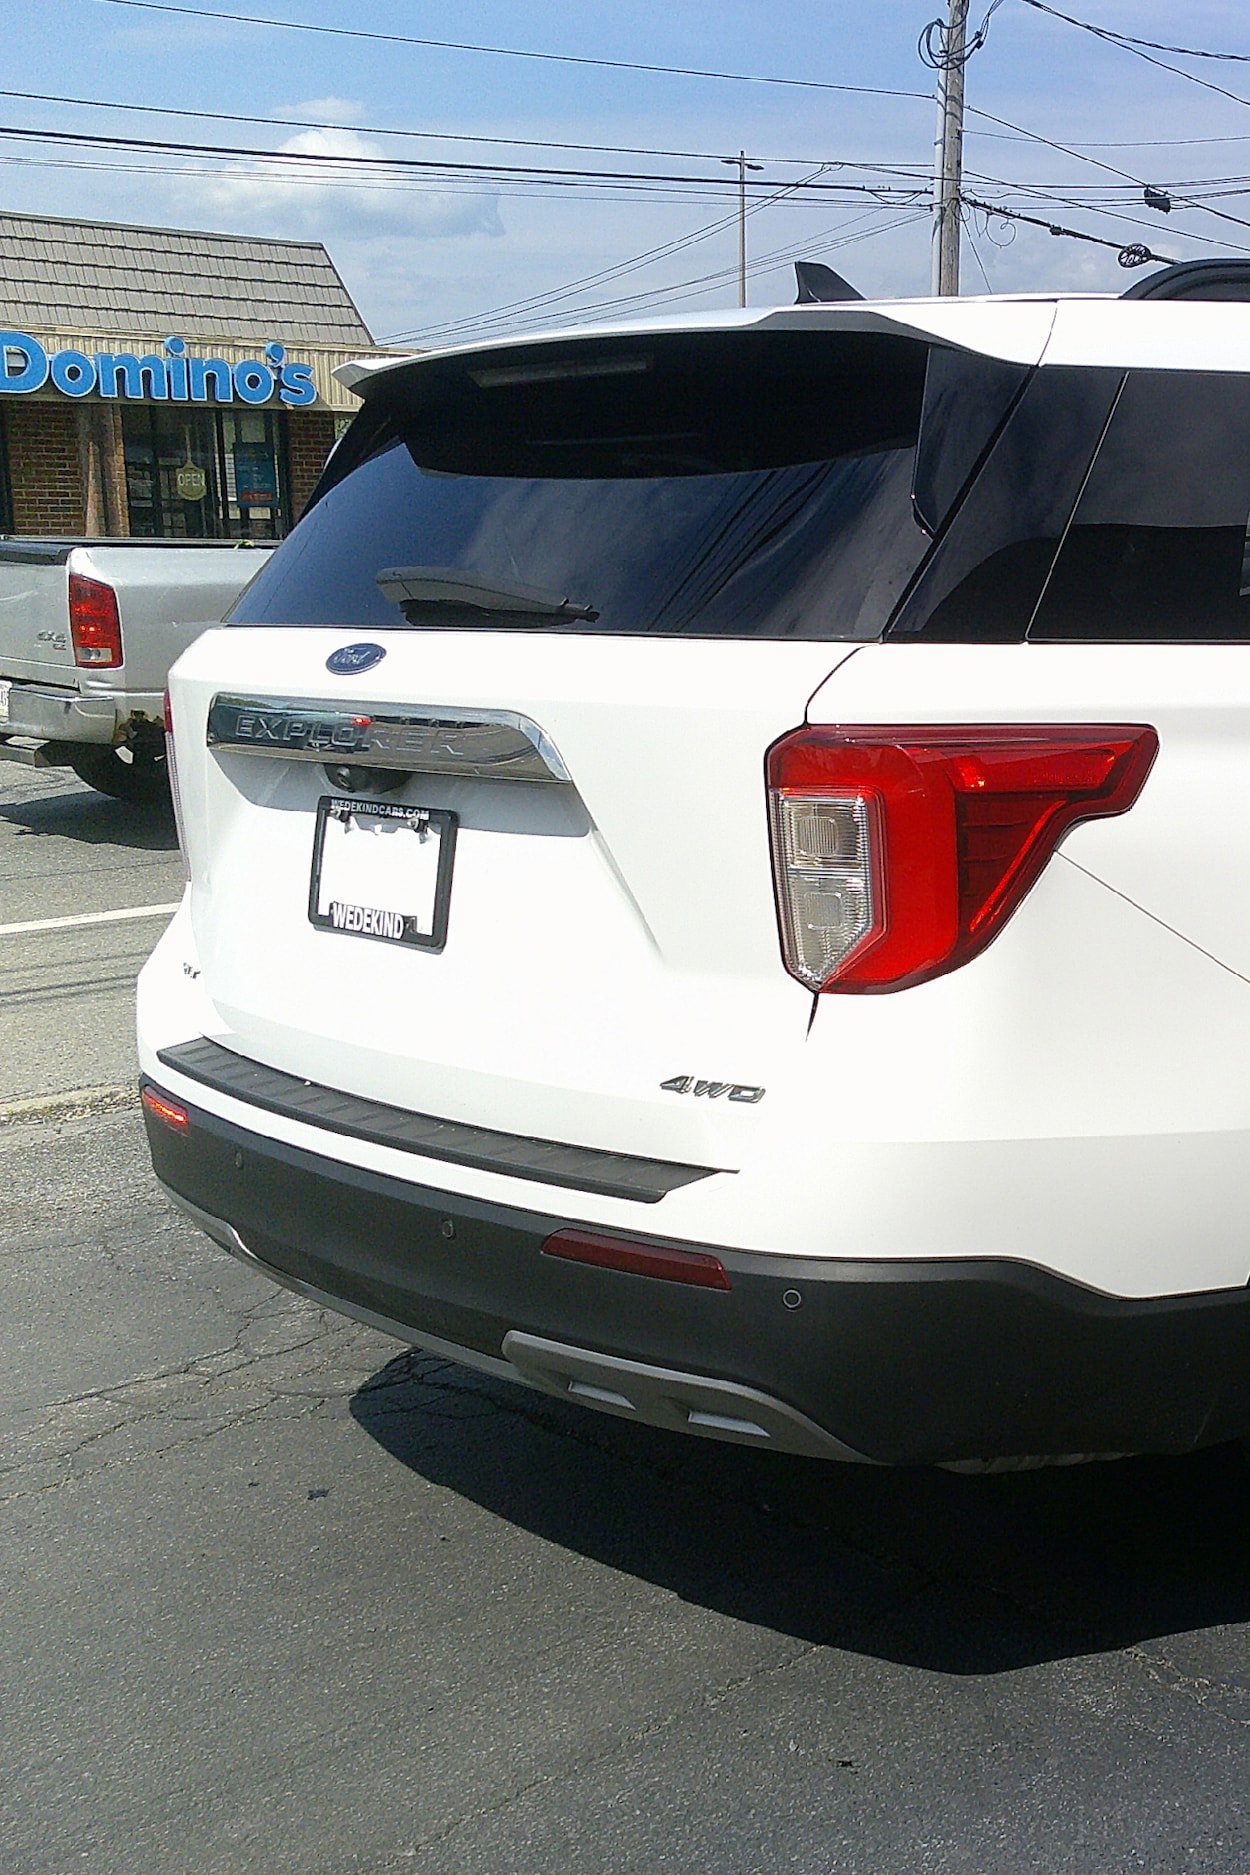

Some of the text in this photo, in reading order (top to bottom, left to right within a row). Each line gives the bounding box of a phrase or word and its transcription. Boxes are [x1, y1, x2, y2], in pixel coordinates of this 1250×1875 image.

[0, 331, 317, 405] Domino's
[177, 473, 206, 487] OPEN
[235, 714, 465, 756] EXPLORER
[331, 799, 430, 820] WEDEKINDCARS.COM
[332, 902, 404, 939] WEDEKIND
[659, 1075, 766, 1104] 4WD
